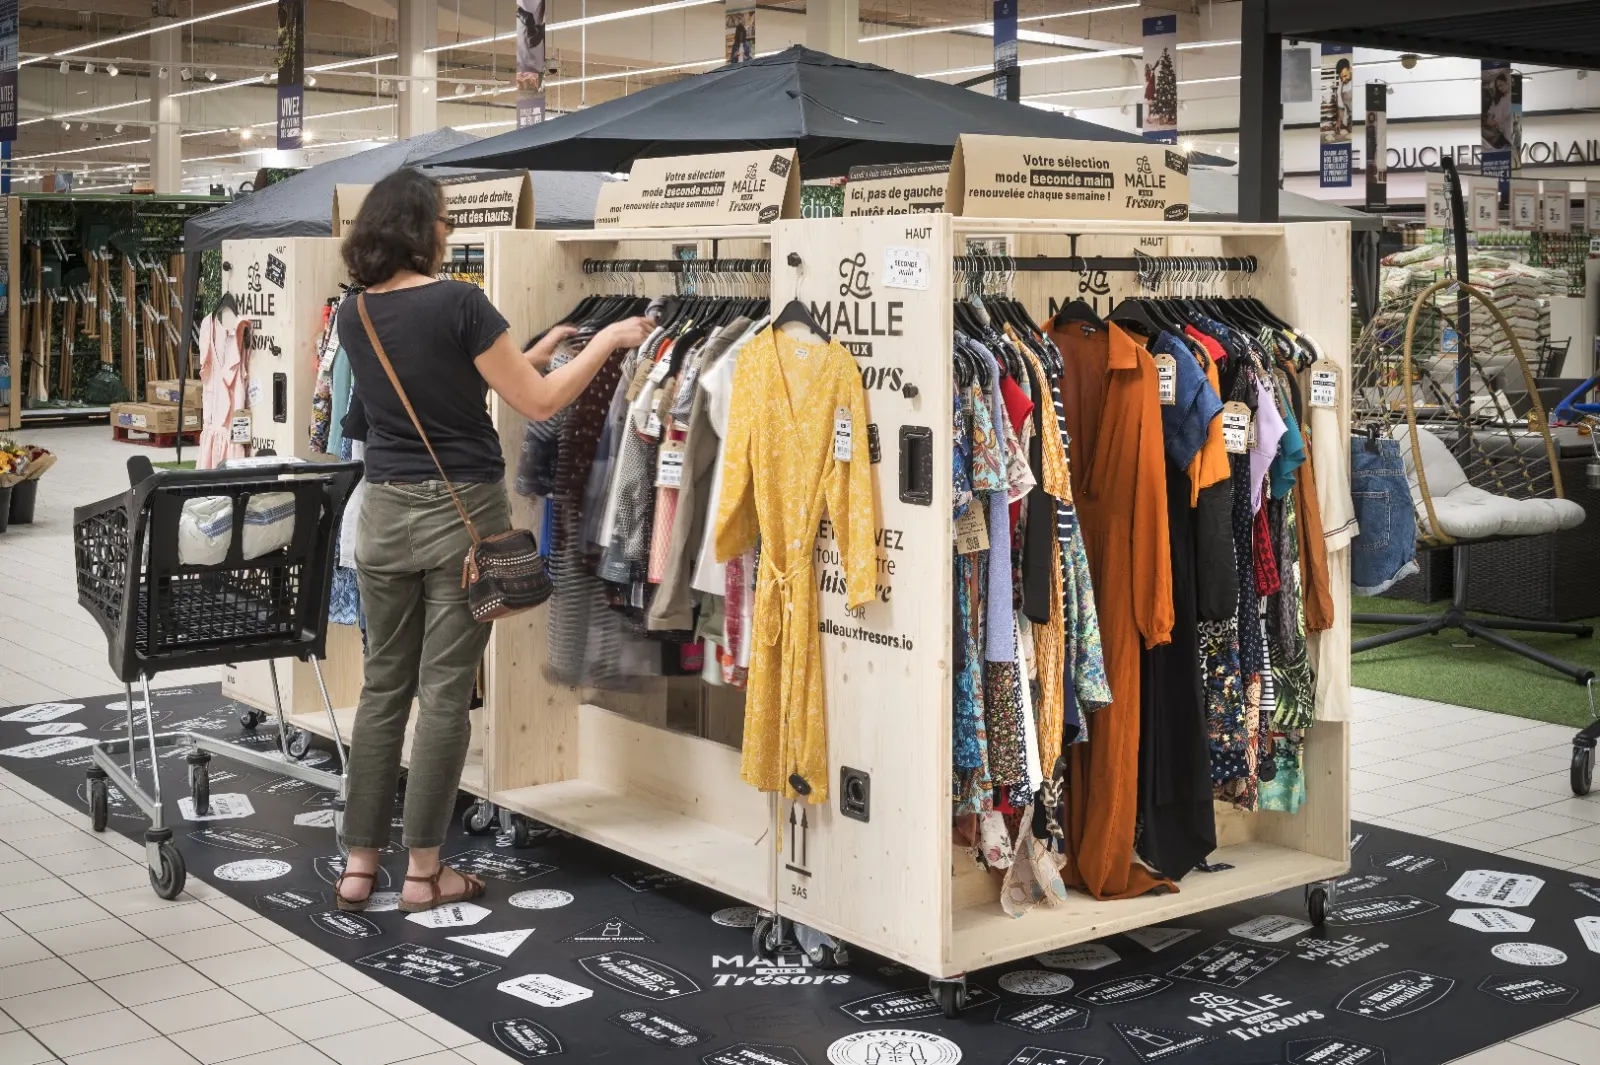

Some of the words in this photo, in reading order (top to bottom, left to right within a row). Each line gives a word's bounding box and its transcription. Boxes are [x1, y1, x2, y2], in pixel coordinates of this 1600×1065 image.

[1023, 154, 1055, 168] Votre
[1058, 156, 1110, 169] sélection
[1386, 145, 1482, 168] OUCHER
[745, 162, 758, 180] La
[1136, 156, 1152, 174] La
[665, 172, 686, 182] Votre
[687, 170, 725, 180] sélection
[995, 172, 1027, 183] mode
[1033, 173, 1081, 185] seconde
[1084, 175, 1111, 186] main
[1125, 174, 1166, 188] MALLE
[642, 187, 664, 197] mode
[666, 185, 700, 197] seconde
[702, 183, 723, 195] main
[732, 179, 767, 193] MALLE
[868, 189, 886, 201] pas
[889, 187, 901, 198] de
[904, 185, 943, 201] gauche
[445, 192, 467, 204] auche
[468, 194, 478, 204] ou
[479, 192, 488, 203] de
[490, 190, 514, 203] droite,
[969, 188, 1025, 199] renouvelée
[1027, 189, 1063, 201] chaque
[1065, 191, 1105, 200] semaine
[1125, 195, 1166, 209] Trésors
[622, 200, 659, 210] renouvelée
[660, 200, 685, 210] chaque
[686, 199, 714, 208] semaine
[729, 201, 762, 212] Trésors
[802, 198, 833, 219] din
[850, 205, 884, 217] plutôt
[887, 204, 907, 216] des
[910, 205, 932, 215] bas
[459, 211, 468, 223] et
[469, 210, 484, 223] des
[485, 209, 511, 222] hauts.
[905, 227, 932, 239] HAUT
[1140, 237, 1164, 246] HAUT
[895, 259, 918, 268] SECONDE
[248, 262, 262, 292] La
[839, 252, 873, 299] La
[1079, 270, 1111, 295] La
[236, 293, 275, 316] MALLE
[811, 301, 903, 336] MALLE
[251, 335, 276, 350] sors
[845, 345, 869, 355] AUX
[252, 437, 275, 450] OUVEZ
[816, 545, 842, 566] tou
[876, 555, 896, 575] tre
[820, 569, 892, 603] hisre
[844, 603, 866, 620] SUR
[818, 619, 913, 651] alleauxtresors.io
[792, 884, 808, 899] BAS
[1340, 903, 1416, 921] trouvailles
[1342, 903, 1390, 914] BELLES
[1297, 934, 1365, 961] MALLE
[1326, 941, 1390, 968] Trésors
[712, 955, 814, 968] MALL
[626, 963, 667, 982] BELLES
[712, 974, 851, 987] Trésors
[1101, 983, 1156, 1000] trouvailles
[1368, 981, 1405, 1002] BELLES
[1374, 981, 1434, 1012] trouvailles
[1513, 987, 1566, 1000] surprises
[886, 994, 934, 1007] BELLE
[1189, 991, 1240, 1009] La
[1187, 994, 1293, 1027] MALLE
[1031, 1008, 1078, 1029] surprises
[1227, 1010, 1325, 1041] Trésors
[845, 1030, 940, 1042] UPCYCLING
[1335, 1048, 1371, 1065] urprises
